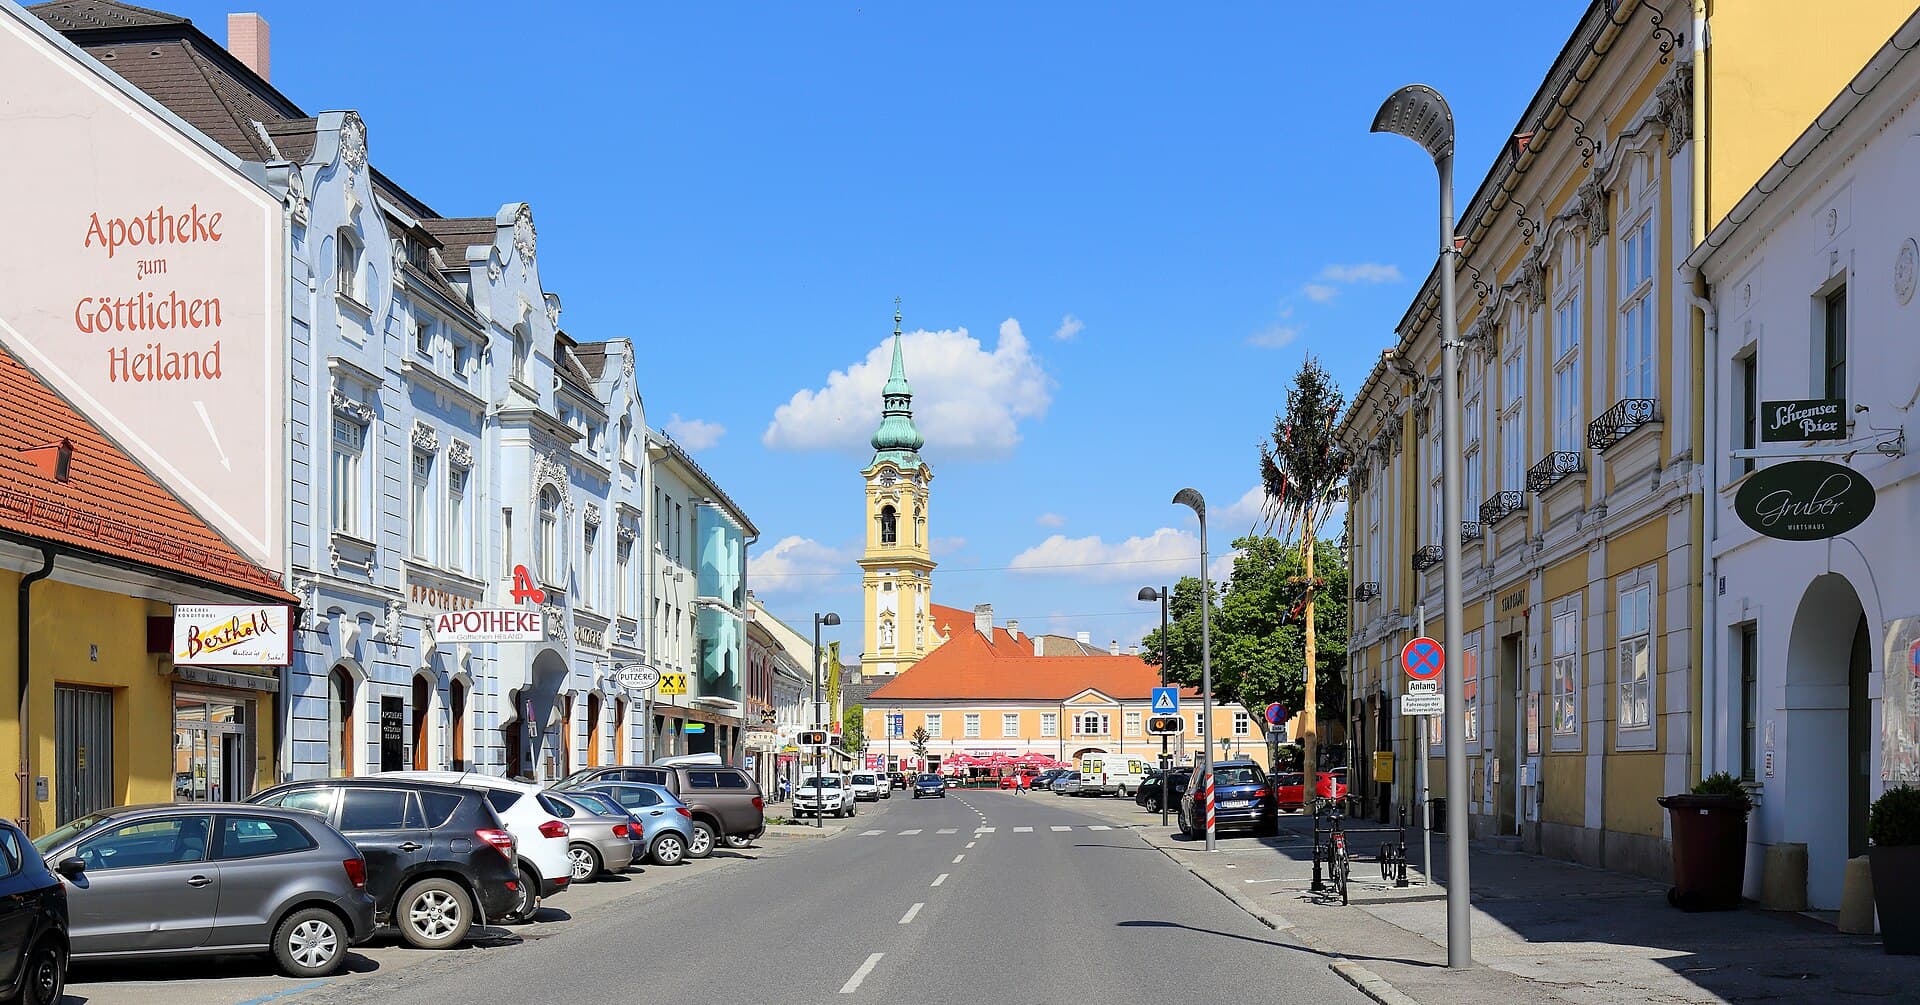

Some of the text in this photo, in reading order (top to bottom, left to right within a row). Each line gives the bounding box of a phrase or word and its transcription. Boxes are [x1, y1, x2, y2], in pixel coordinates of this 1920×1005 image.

[85, 203, 223, 258] Apotheke
[136, 257, 167, 280] zum
[75, 290, 222, 333] Göttlichen
[108, 341, 222, 383] Heiland
[1770, 403, 1838, 430] Schremser
[1799, 418, 1838, 437] Bier
[1755, 473, 1852, 527] Gruber
[1787, 523, 1825, 531] WIRTSHAUS
[411, 584, 475, 611] APOTHEKE
[188, 609, 277, 659] Berthold
[437, 611, 540, 633] APOTHEKE
[620, 673, 656, 681] PUTZEREI
